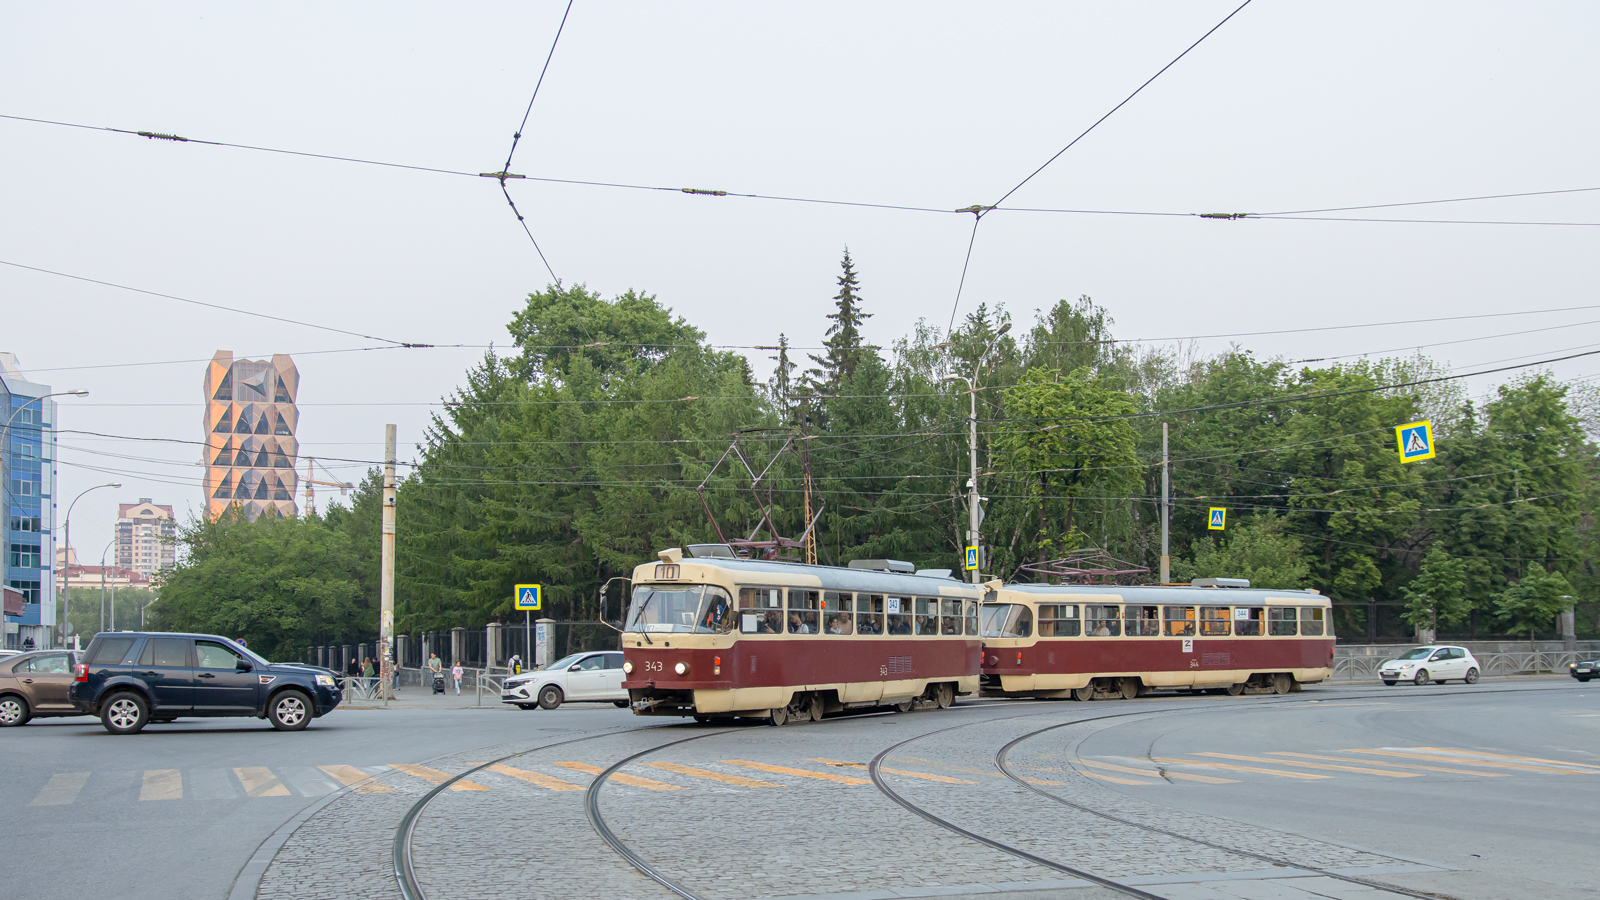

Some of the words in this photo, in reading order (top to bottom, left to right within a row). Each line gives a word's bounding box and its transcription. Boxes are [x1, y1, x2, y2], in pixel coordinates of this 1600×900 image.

[661, 566, 675, 579] 10
[889, 599, 898, 609] 343
[1237, 609, 1247, 617] 344
[645, 661, 663, 672] 343
[1190, 660, 1199, 669] 344
[879, 667, 888, 676] 343
